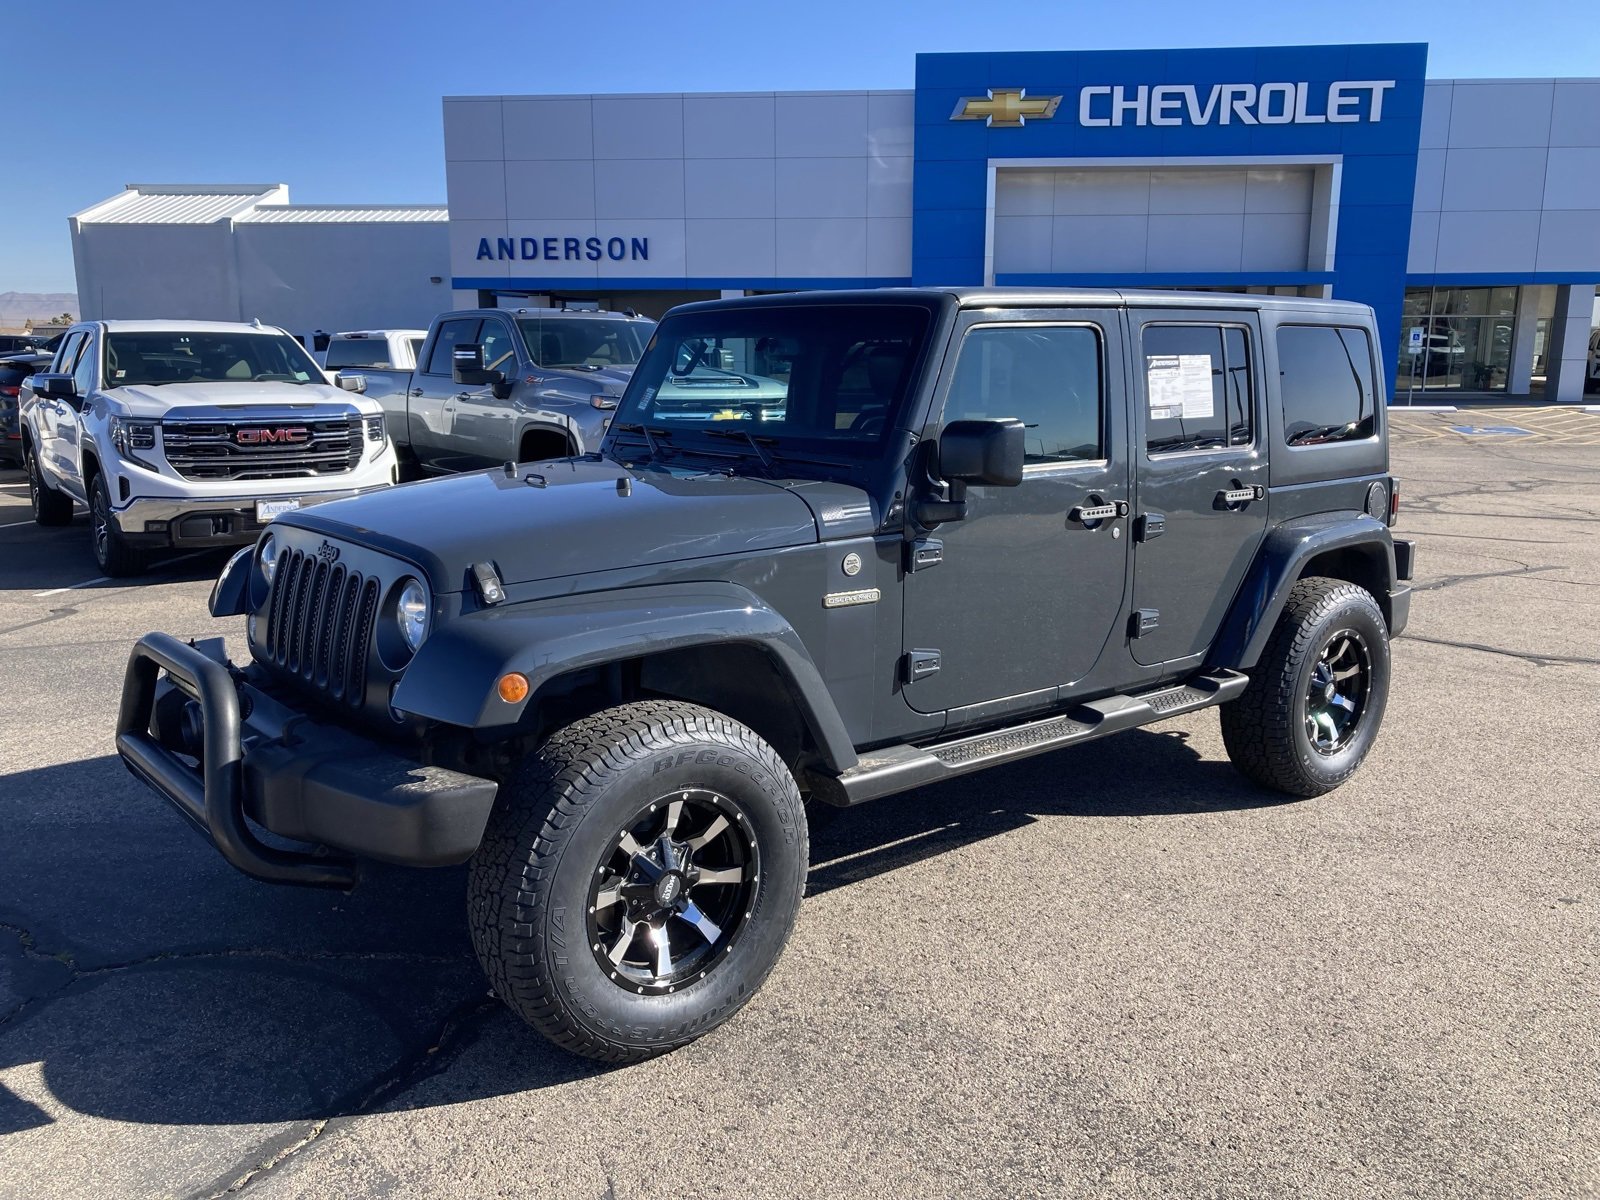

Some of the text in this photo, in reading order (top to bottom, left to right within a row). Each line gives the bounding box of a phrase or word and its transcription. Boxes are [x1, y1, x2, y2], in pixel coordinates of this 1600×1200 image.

[1079, 79, 1396, 127] CHEVROLET
[476, 236, 649, 261] ANDERSON
[237, 428, 308, 443] GMC
[652, 749, 796, 846] BFGoodrich
[551, 906, 570, 971] T/A
